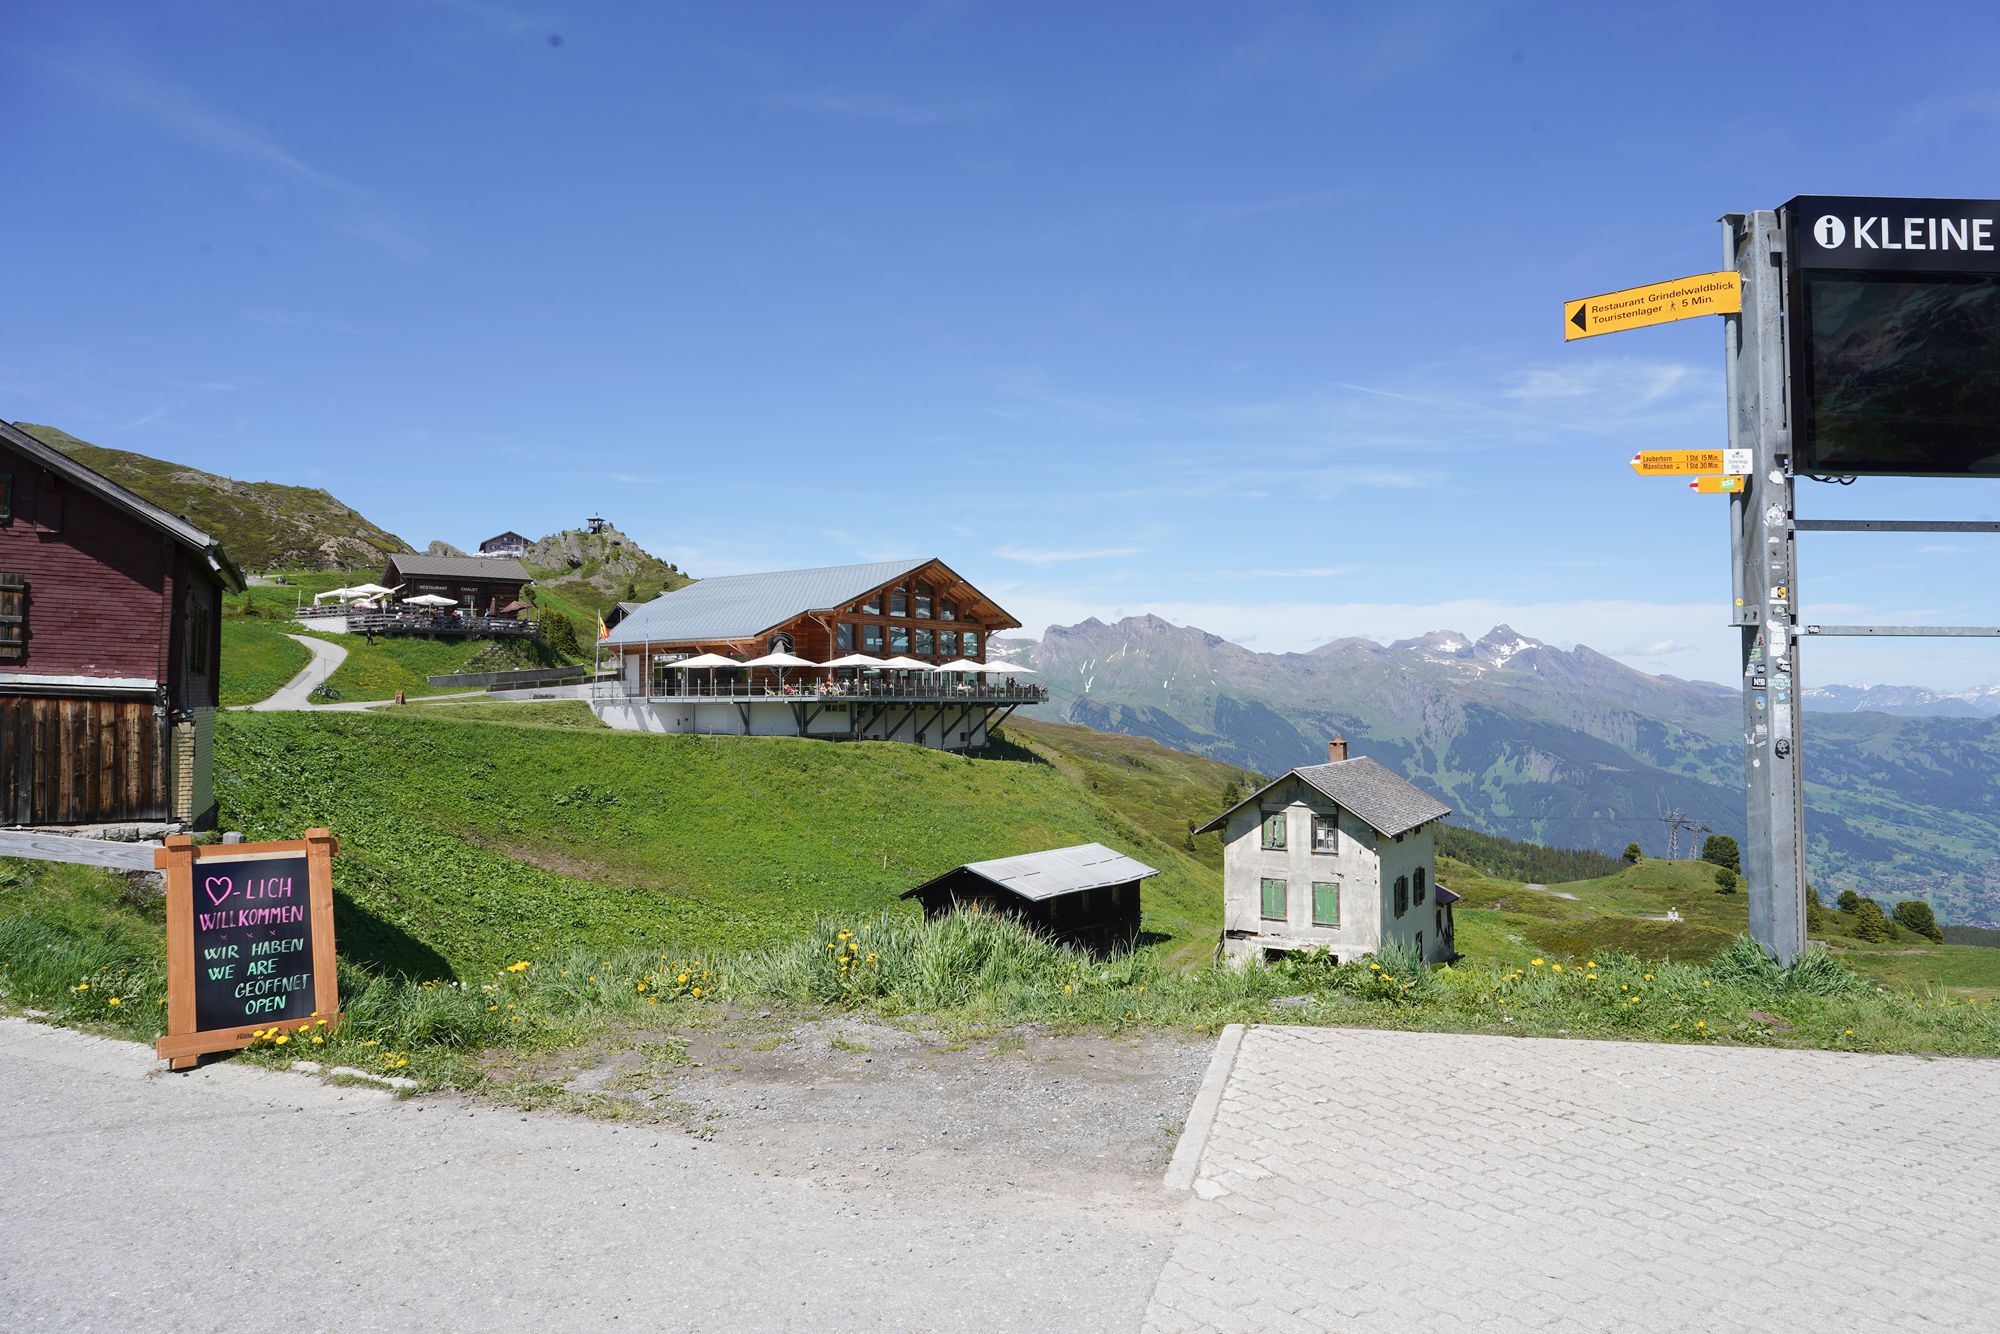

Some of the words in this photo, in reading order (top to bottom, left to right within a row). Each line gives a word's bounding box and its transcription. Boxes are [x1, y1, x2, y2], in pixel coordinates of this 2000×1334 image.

[1853, 216, 1995, 251] KLEINE
[1592, 297, 1645, 314] Restaurant
[1648, 281, 1734, 303] Grindelwaldblick
[1592, 305, 1663, 324] Touristenlager
[1682, 298, 1689, 307] 5
[1692, 295, 1714, 305] Min.
[1643, 462, 1674, 470] Männlichen
[199, 905, 304, 932] WILLKOMMEN
[204, 945, 240, 960] WIR
[251, 938, 304, 956] HABEN
[208, 964, 236, 981] WE
[247, 958, 279, 976] ARE
[234, 973, 311, 999] GEÖFFNET
[245, 994, 287, 1015] OPEN
